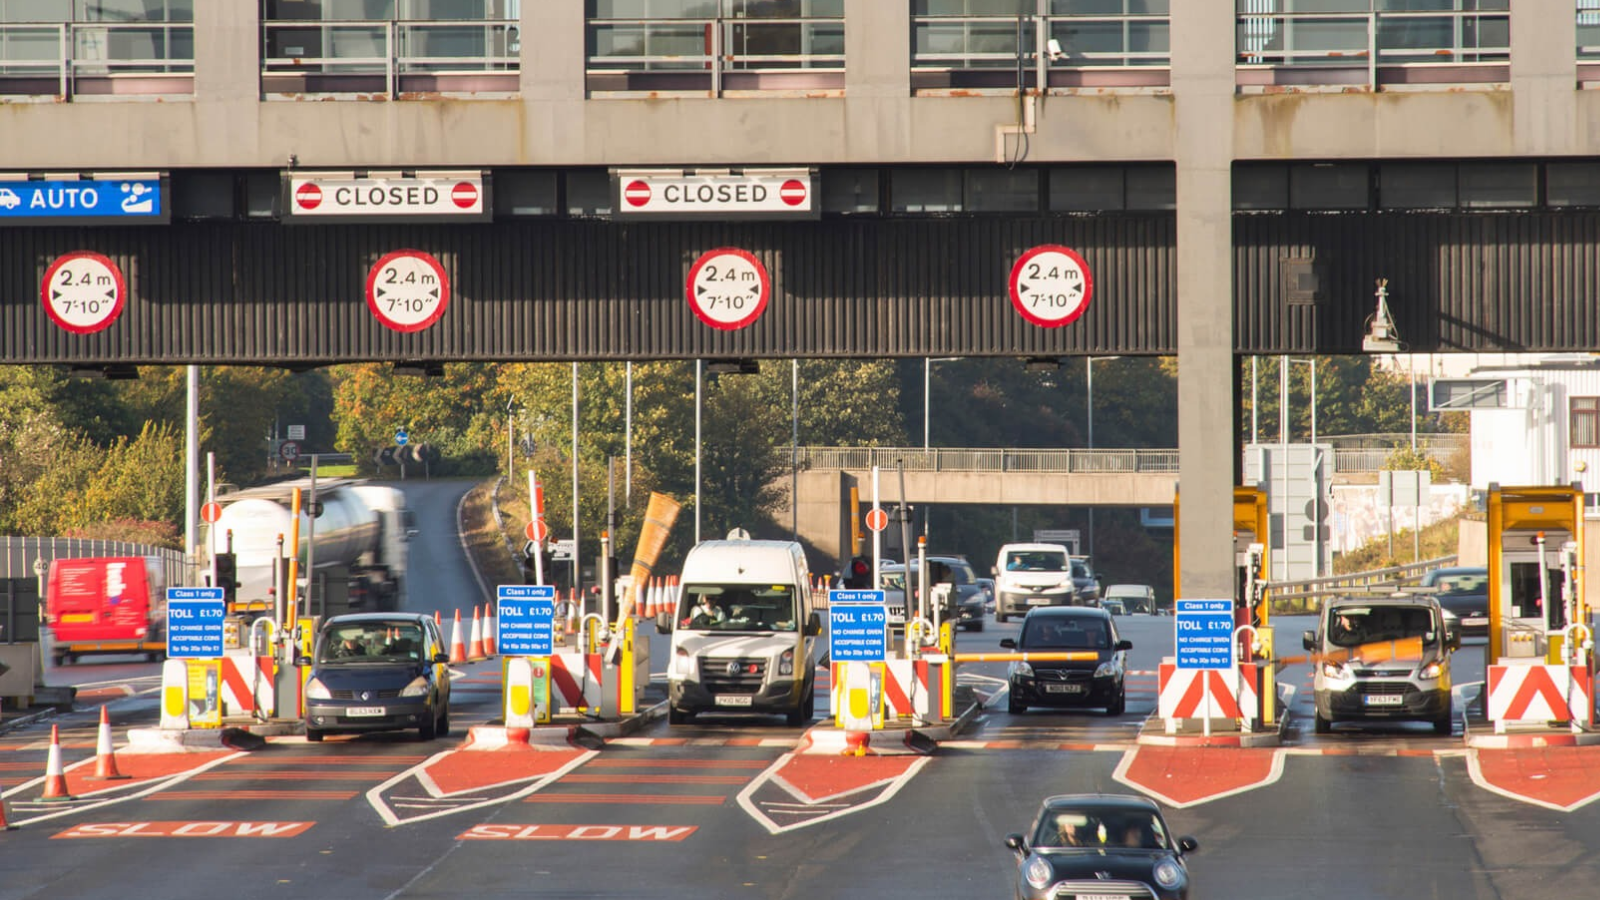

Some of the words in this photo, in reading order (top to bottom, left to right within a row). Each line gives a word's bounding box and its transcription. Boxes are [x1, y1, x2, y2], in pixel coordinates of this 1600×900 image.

[30, 188, 98, 209] AUTO
[335, 187, 438, 206] CLOSED
[664, 185, 767, 203] CLOSED
[60, 270, 92, 286] 2.4
[97, 275, 111, 285] m
[385, 268, 416, 285] 2.4
[421, 274, 435, 284] m
[705, 265, 737, 282] 2.4
[742, 271, 755, 281] m
[1028, 263, 1059, 280] 2.4
[1064, 269, 1078, 279] m
[200, 590, 216, 598] only
[169, 609, 194, 618] TOLL
[200, 609, 223, 618] £1.70
[499, 607, 524, 616] TOLL
[529, 607, 552, 616] £1.70
[1184, 602, 1203, 610] Class
[832, 613, 856, 622] TOLL
[861, 613, 884, 622] £1.70
[1178, 621, 1202, 630] TOLL
[1208, 622, 1231, 630] £1.70
[66, 822, 303, 837] SLOW
[463, 825, 691, 839] SLOW
